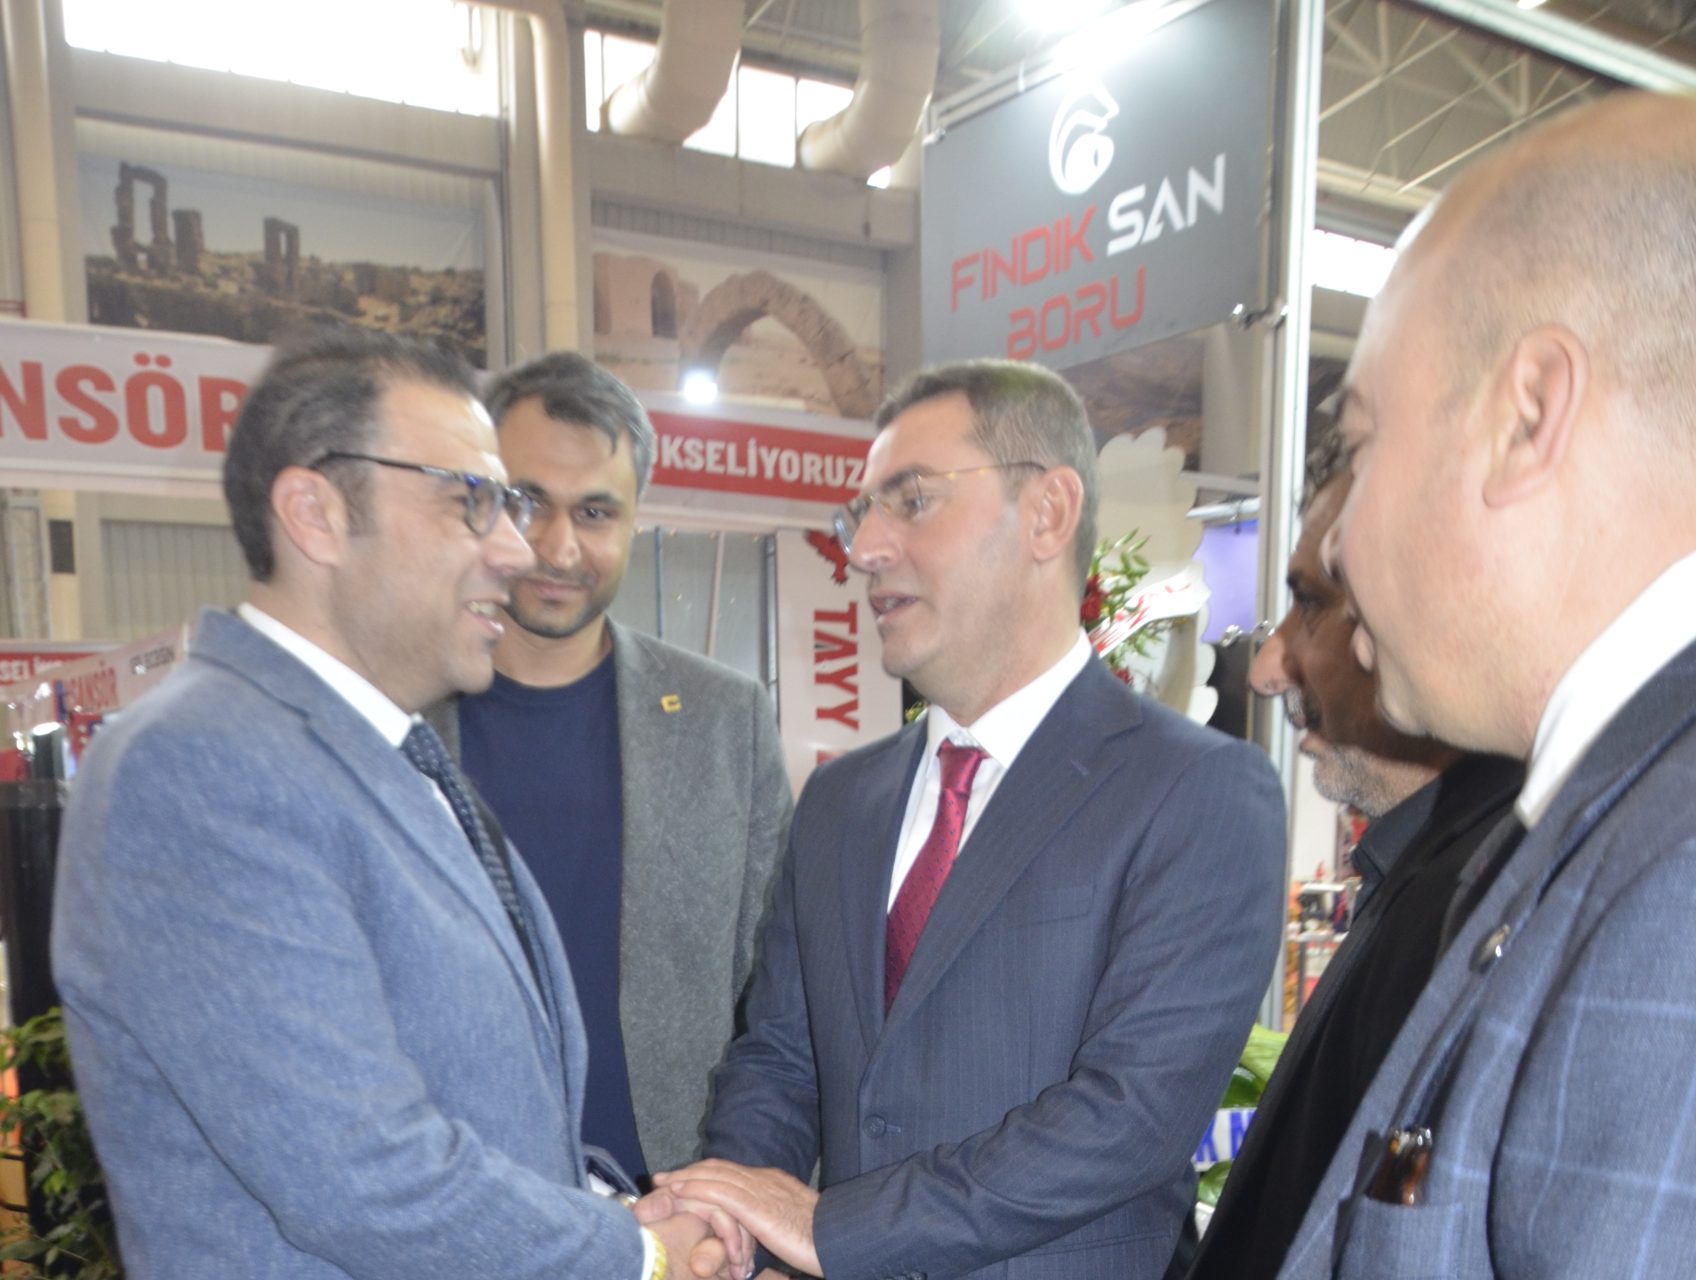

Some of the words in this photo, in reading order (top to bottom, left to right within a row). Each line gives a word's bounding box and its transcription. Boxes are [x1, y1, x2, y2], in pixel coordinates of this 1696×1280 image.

[950, 203, 1097, 313] FINDIK
[1106, 152, 1226, 257] SAN
[1007, 263, 1146, 362] BORU
